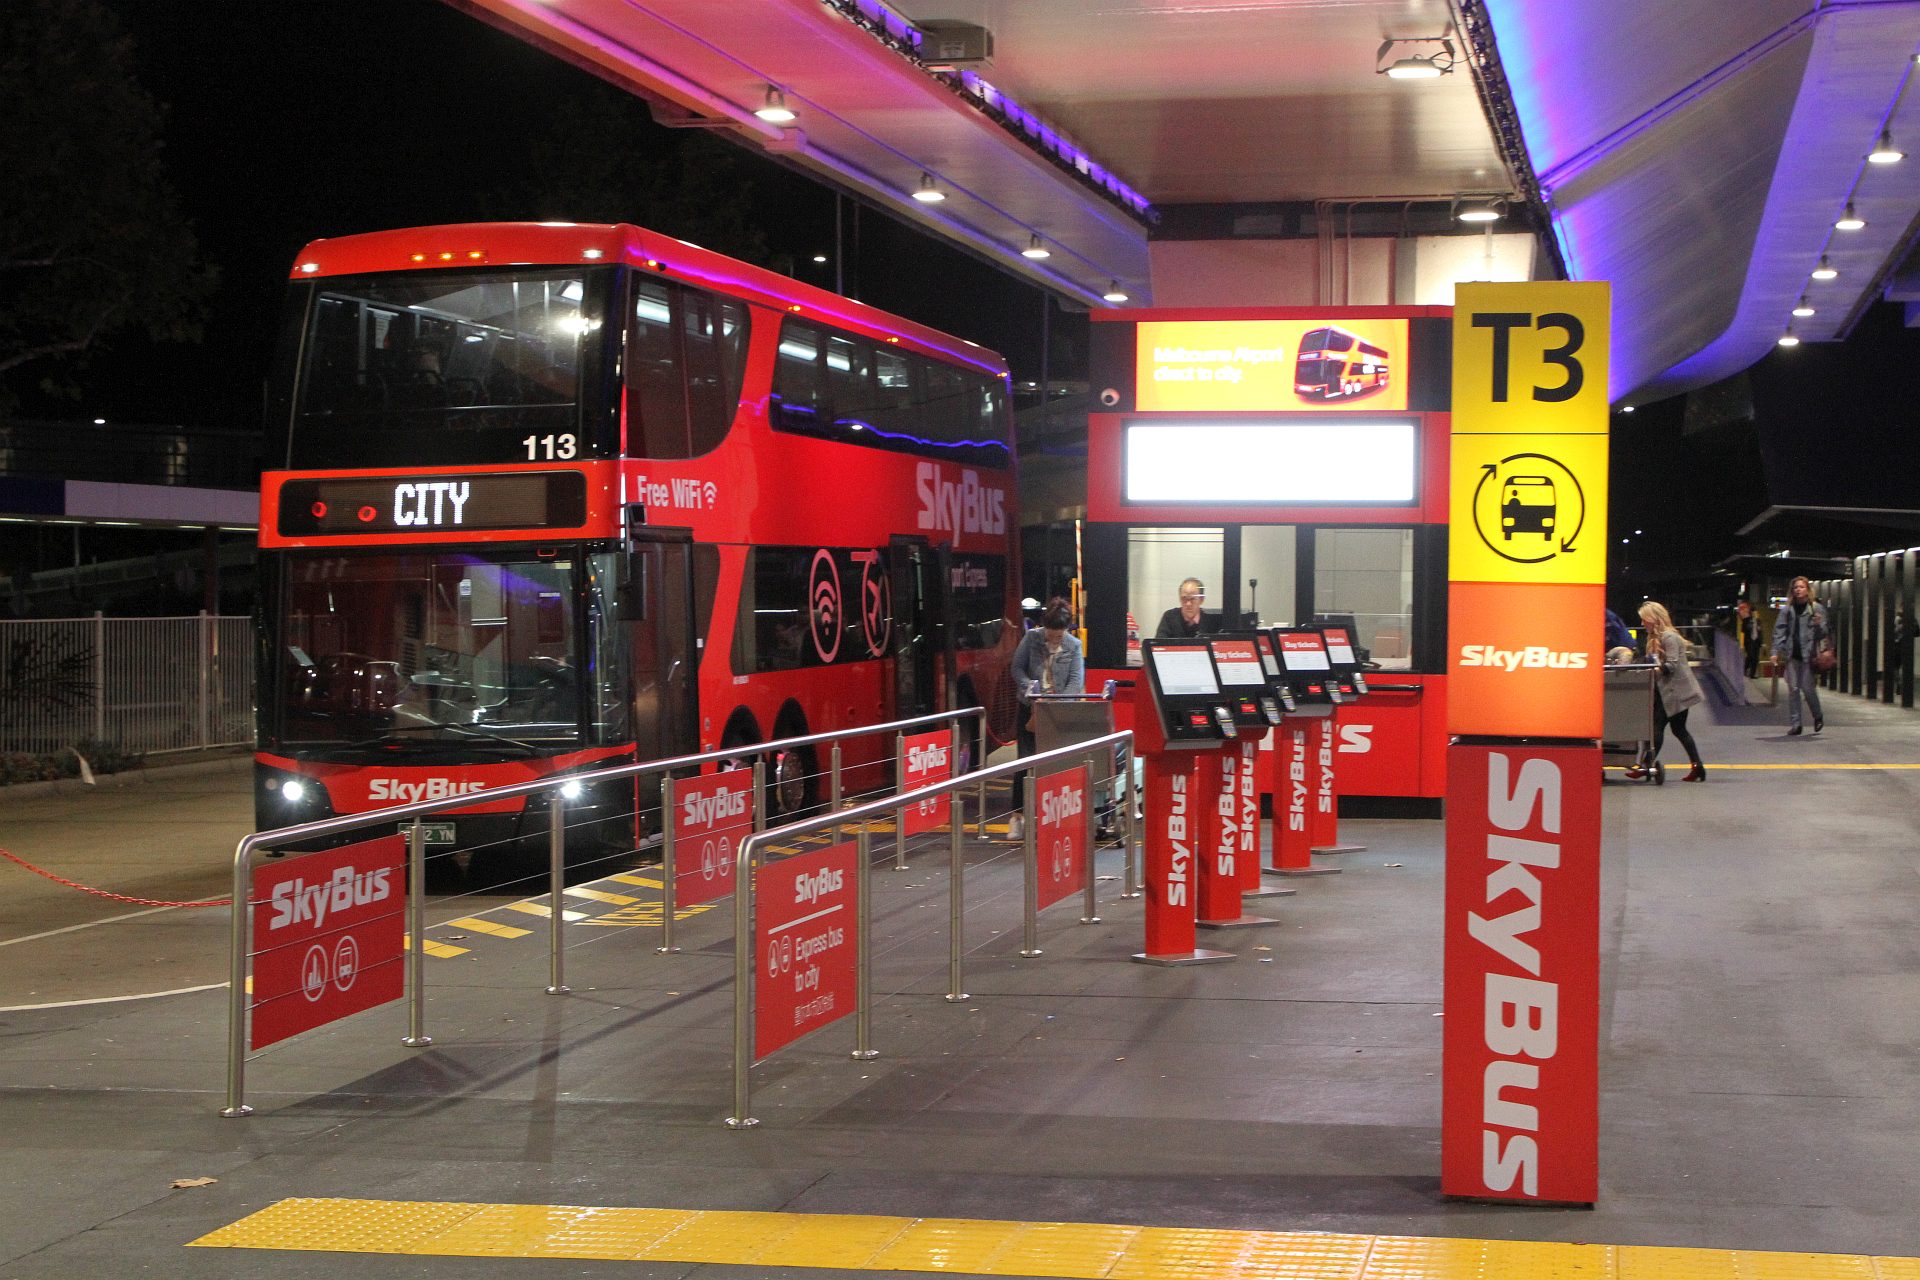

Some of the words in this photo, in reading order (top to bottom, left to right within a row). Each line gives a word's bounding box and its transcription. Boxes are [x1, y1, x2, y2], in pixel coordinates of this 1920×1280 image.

[1153, 366, 1194, 381] direct
[1196, 367, 1212, 381] to
[1233, 346, 1284, 365] Airport
[1472, 312, 1586, 403] T3
[523, 434, 577, 460] 113
[394, 481, 470, 527] CITY
[637, 476, 669, 508] Free
[671, 478, 702, 509] WiFi
[915, 461, 1005, 547] SkyBus
[1459, 645, 1588, 673] SkyBus
[907, 743, 947, 776] SkyBus
[1318, 719, 1335, 814] SkyBus
[368, 778, 486, 802] SkyBus
[1241, 742, 1258, 852] SkyBus
[1290, 731, 1308, 832] SkyBus
[683, 786, 747, 829] SkyBus
[1041, 785, 1083, 829] SkyBus
[1218, 756, 1239, 877] SkyBus
[1168, 775, 1190, 907] SkyBus
[269, 866, 391, 931] SkyBus
[795, 867, 843, 905] SkyBus
[795, 933, 828, 963] Express
[828, 927, 844, 949] bus
[795, 970, 804, 992] to
[805, 963, 821, 991] city
[1467, 751, 1562, 1197] SkyBus
